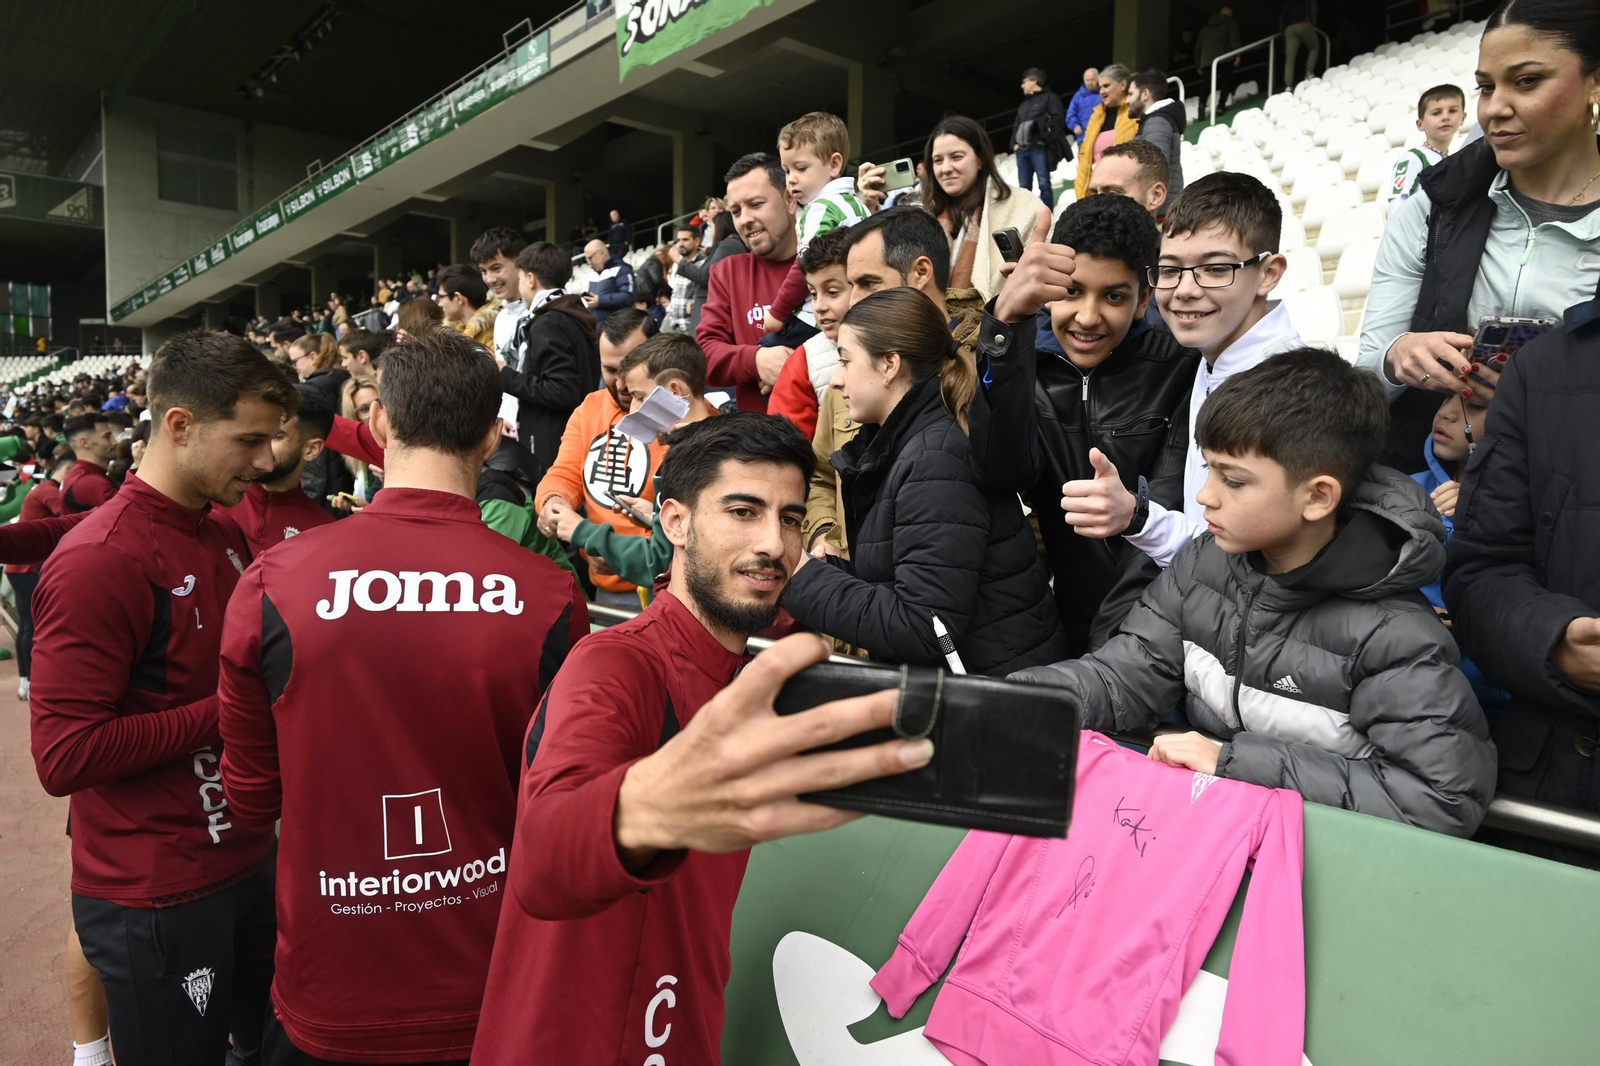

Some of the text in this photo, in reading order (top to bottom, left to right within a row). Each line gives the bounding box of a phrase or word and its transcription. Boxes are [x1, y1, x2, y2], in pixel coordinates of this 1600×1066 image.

[66, 203, 87, 217] 90
[290, 167, 351, 214] SILBON SILBON
[319, 847, 506, 897] interiorwood
[330, 903, 382, 916] Gestión
[395, 895, 462, 914] Proyectos
[472, 881, 498, 899] Visual
